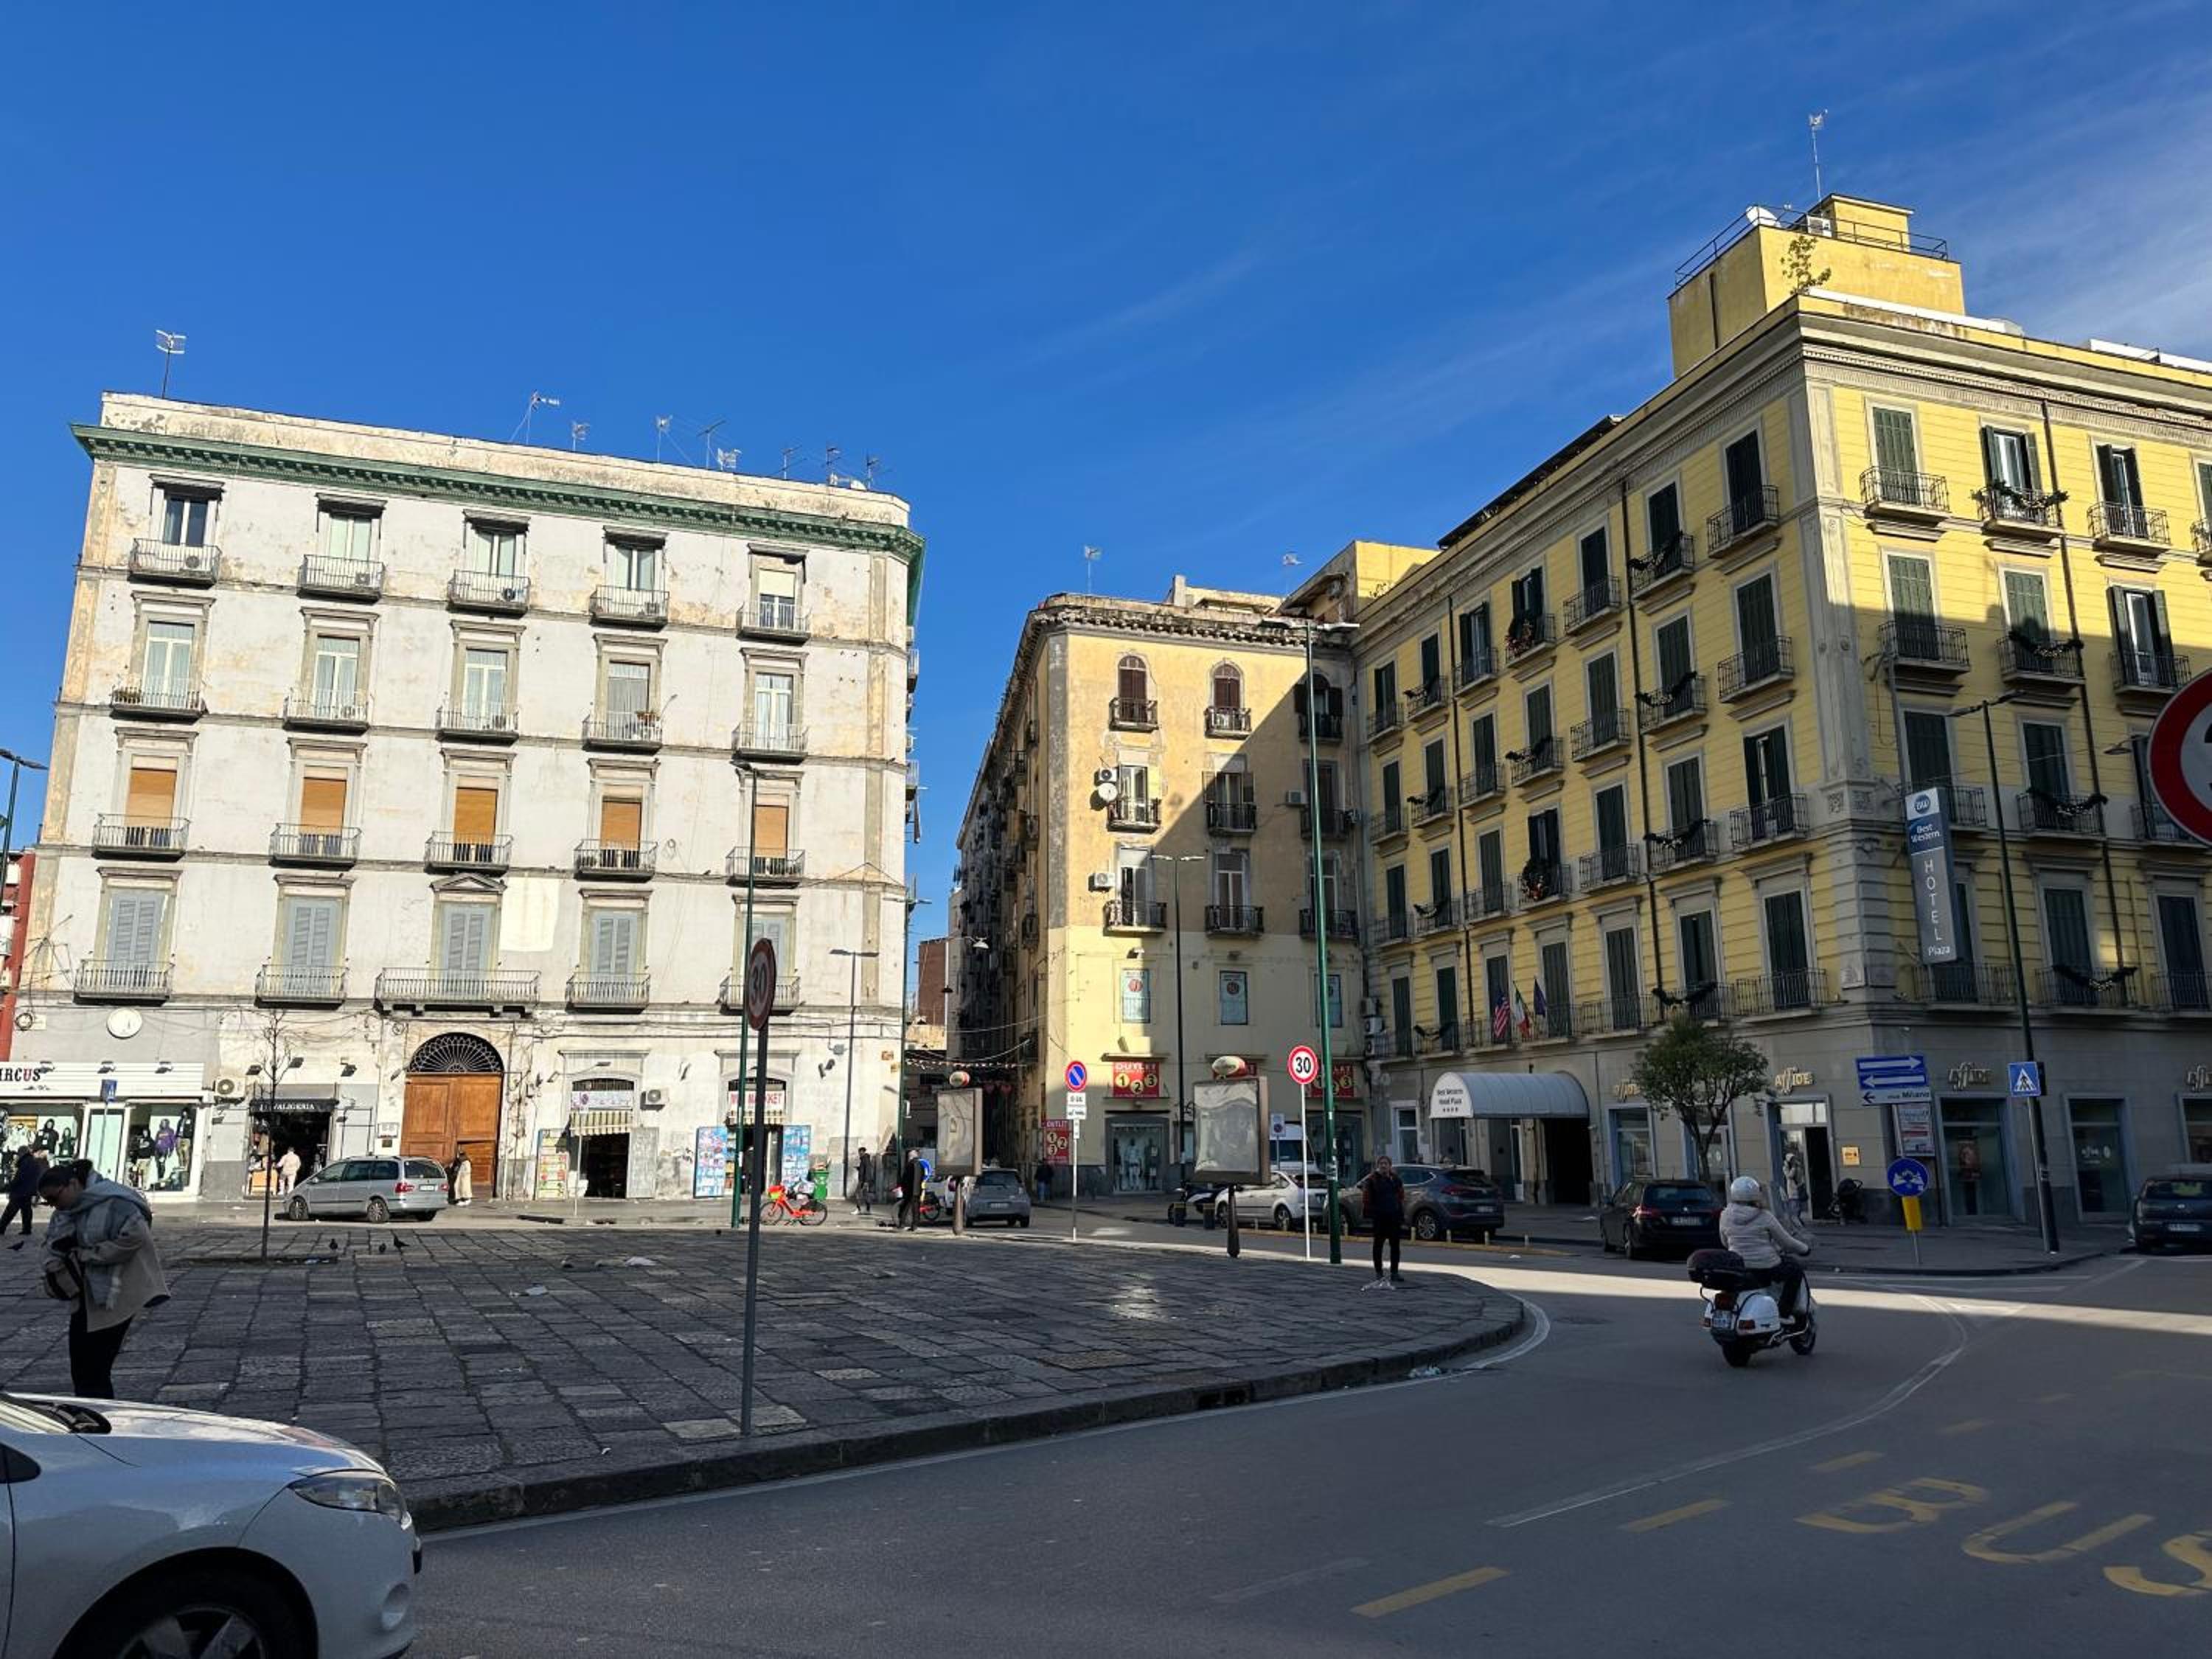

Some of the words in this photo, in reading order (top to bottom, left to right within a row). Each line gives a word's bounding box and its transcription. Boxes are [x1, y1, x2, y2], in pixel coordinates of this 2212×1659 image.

[1917, 824, 1933, 833] Best
[1911, 831, 1940, 843] Western
[1924, 859, 1943, 940] HOTEL
[1928, 946, 1950, 956] Plaza
[751, 962, 767, 1006] 30
[1115, 1062, 1157, 1070] OUTLET
[1295, 1057, 1312, 1074] 30
[1793, 1477, 2212, 1596] BUS
